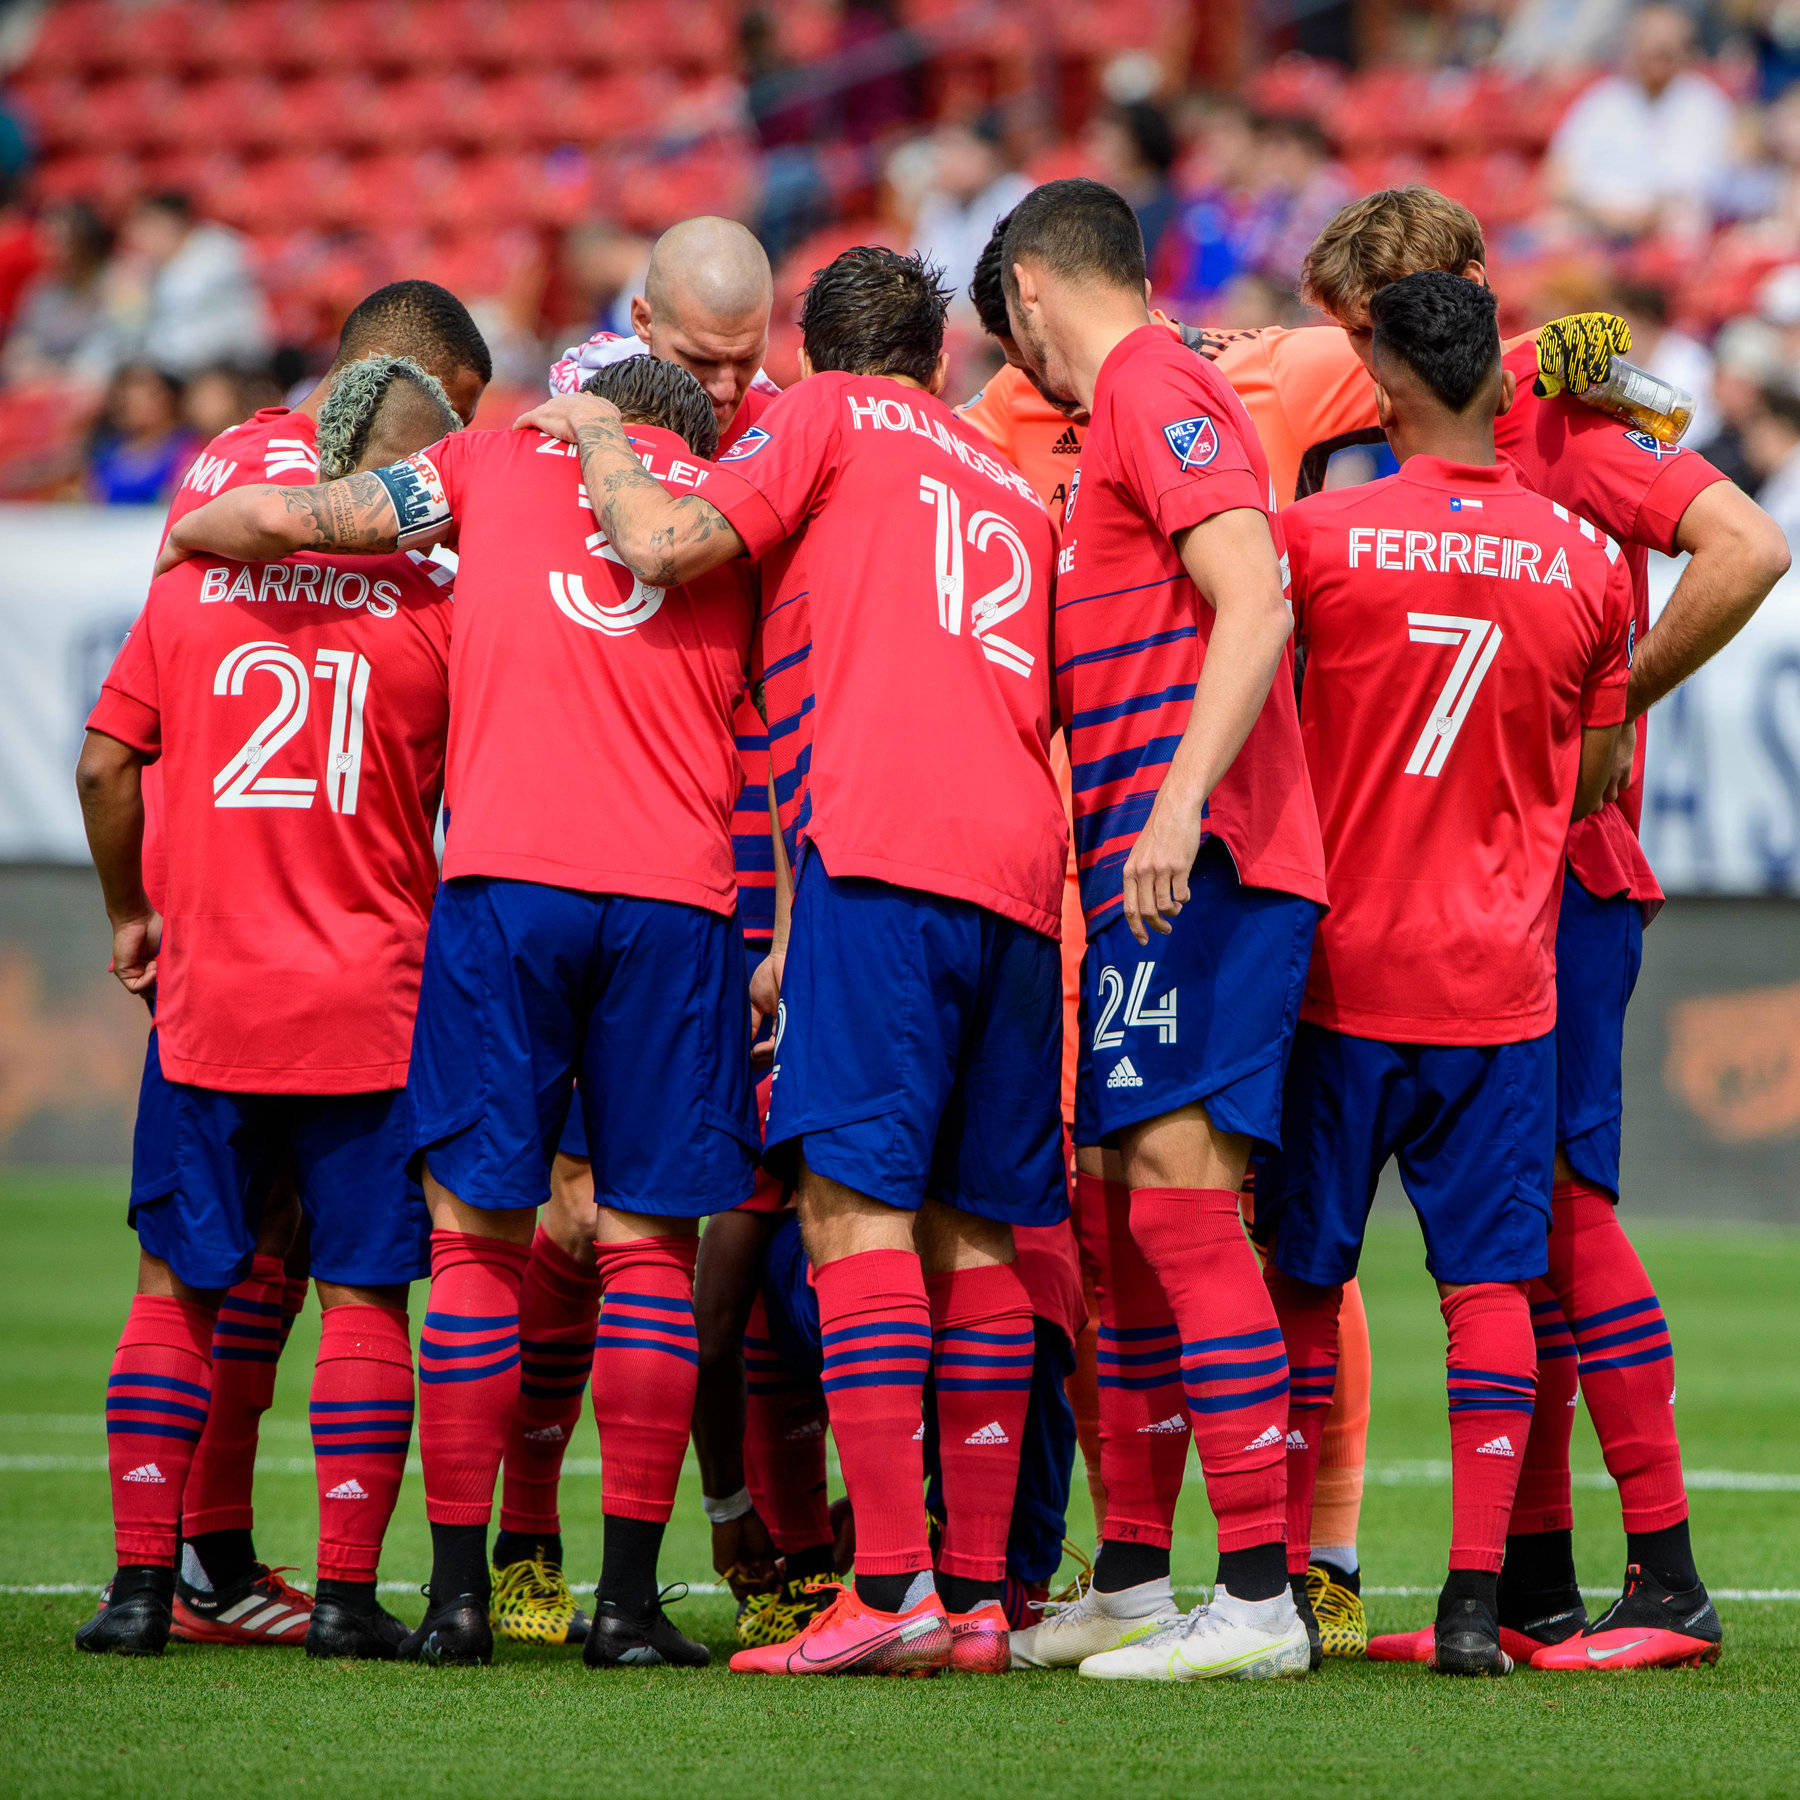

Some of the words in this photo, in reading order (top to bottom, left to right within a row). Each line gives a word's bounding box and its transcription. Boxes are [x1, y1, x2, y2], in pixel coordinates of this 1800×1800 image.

[1170, 423, 1196, 440] MLS
[1198, 442, 1212, 453] 25
[431, 490, 446, 505] 3
[549, 483, 666, 637] 3
[1348, 527, 1573, 589] FERREIRA
[919, 474, 1035, 679] 12
[199, 563, 402, 618] BARRIOS
[1403, 611, 1503, 778] 7
[213, 640, 372, 816] 21
[1092, 961, 1177, 1051] 24
[1107, 1076, 1143, 1089] adidas
[965, 1436, 1009, 1445] adidas
[1243, 1434, 1284, 1451] adidas
[1476, 1447, 1515, 1457] adidas
[122, 1474, 166, 1483] adidas
[1118, 1526, 1138, 1539] 24
[904, 1555, 920, 1568] 12
